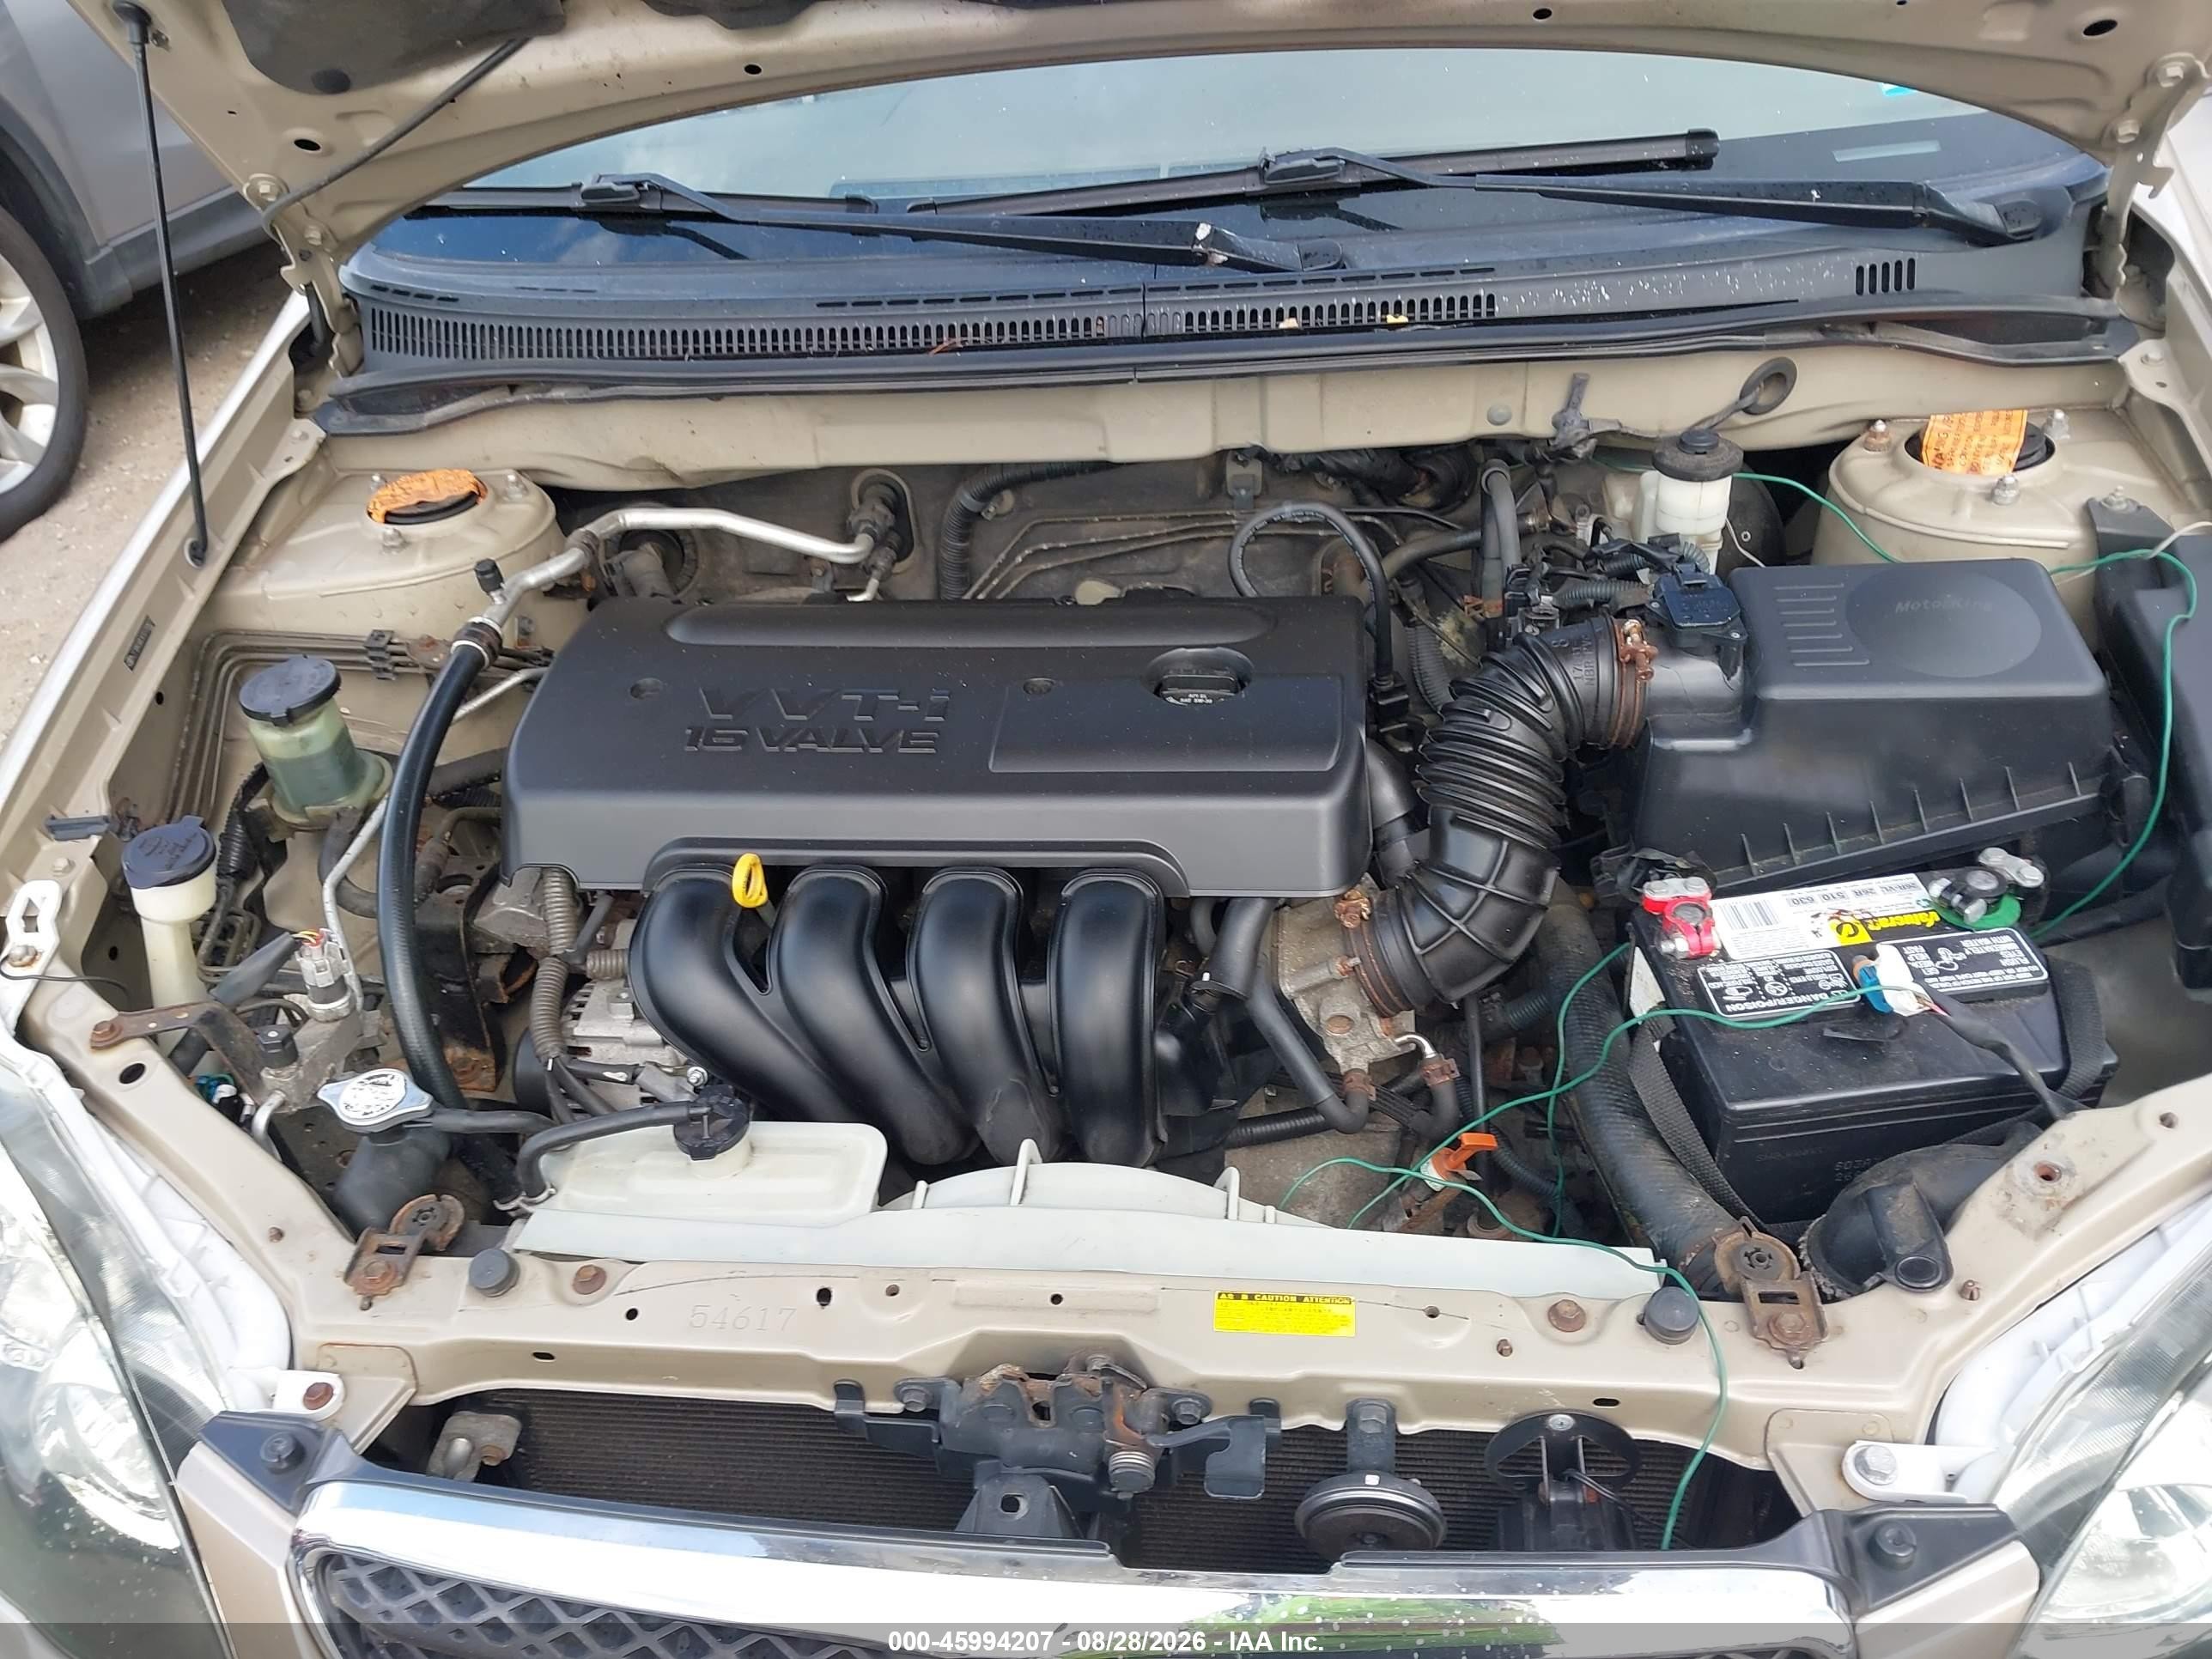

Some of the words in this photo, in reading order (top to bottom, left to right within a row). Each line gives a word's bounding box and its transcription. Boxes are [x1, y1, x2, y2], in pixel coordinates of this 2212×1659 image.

[699, 687, 951, 721] VVT-i
[684, 728, 749, 752] 16
[756, 728, 939, 754] VALVE
[1790, 896, 1814, 905] 630
[1822, 891, 1844, 901] 510
[1725, 992, 1829, 1012] DANGER/POISON
[1254, 1293, 1297, 1302] CAUTION
[1303, 1296, 1351, 1304] ATTENTION
[689, 1304, 798, 1332] 54617
